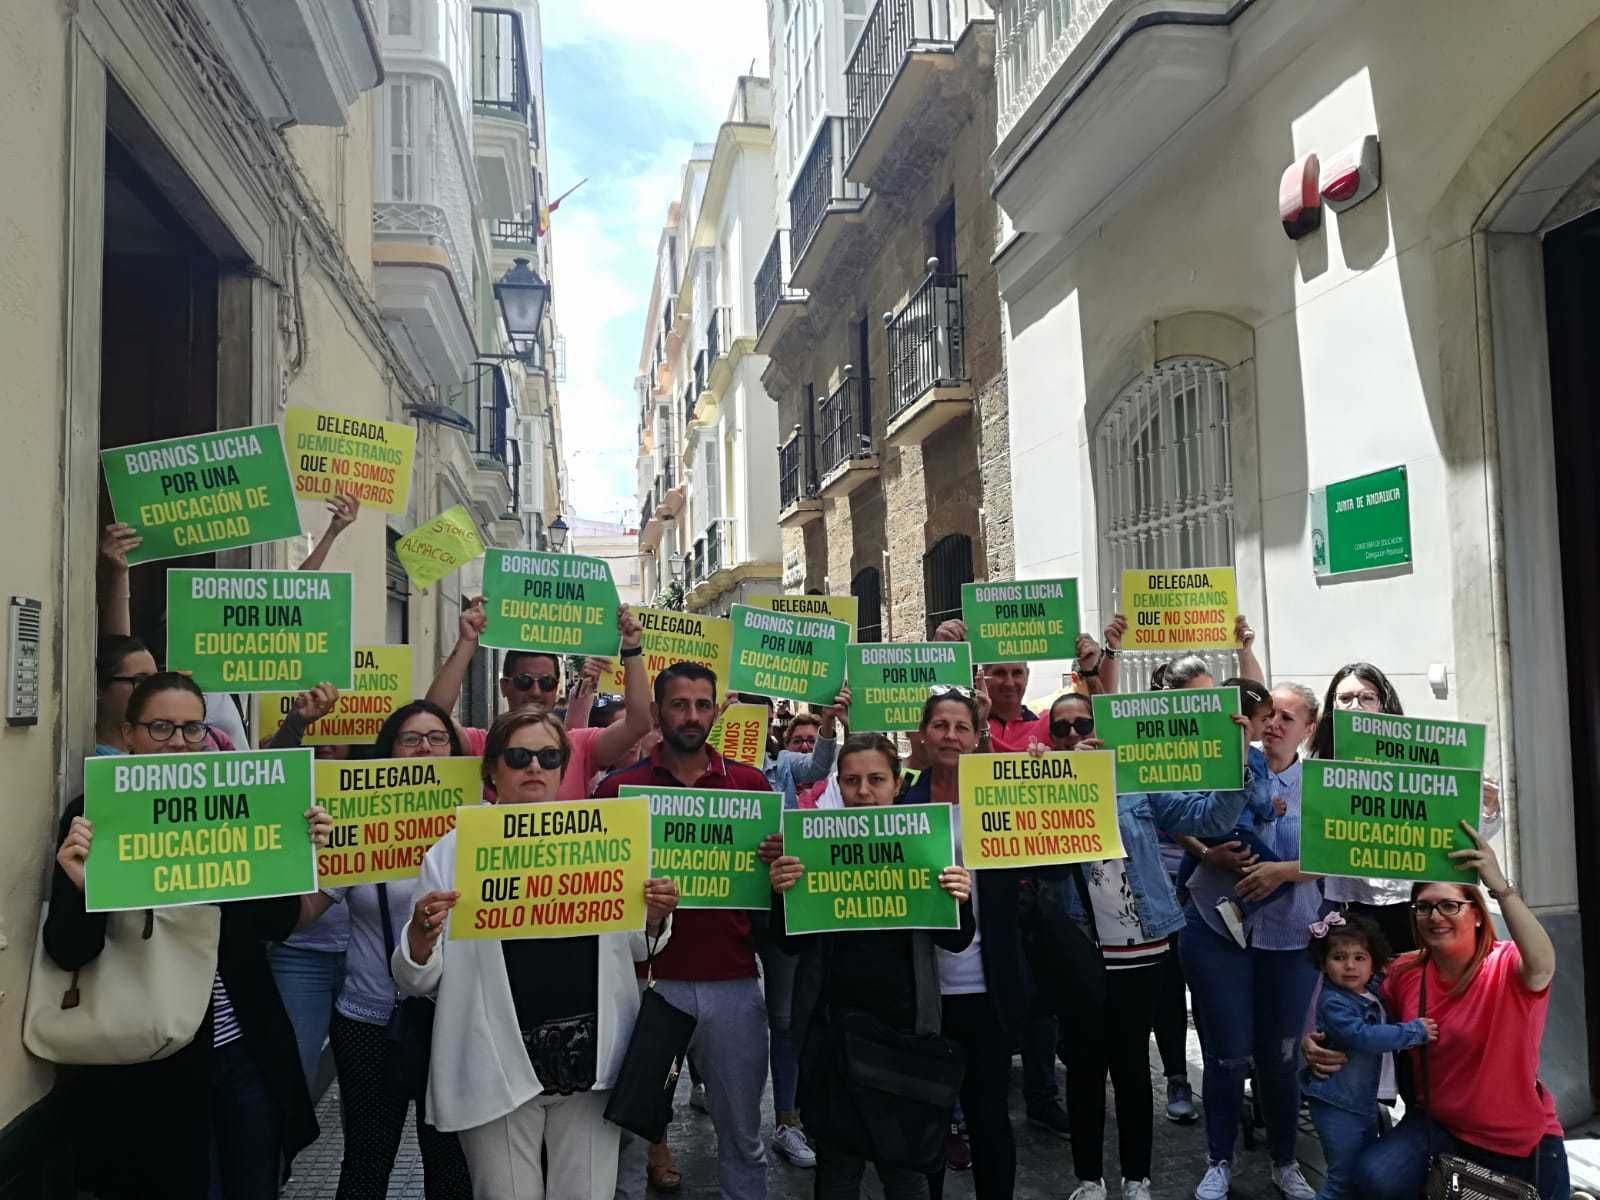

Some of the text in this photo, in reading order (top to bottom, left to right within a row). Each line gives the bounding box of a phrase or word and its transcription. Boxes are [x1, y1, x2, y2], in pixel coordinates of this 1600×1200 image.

[317, 415, 388, 444] DELEGADA,
[125, 435, 262, 475] BORNOS LUCHA
[297, 431, 402, 465] DEMUÉSTRANOS
[161, 465, 240, 495] POR UNA
[300, 454, 395, 484] QUE NO SOMOS
[296, 475, 394, 504] SOLO NÚM3ROS
[140, 486, 270, 526] EDUCACIÓN DE
[1336, 498, 1354, 512] JUNTA
[1356, 496, 1364, 508] DE
[174, 516, 250, 546] CALIDAD
[502, 555, 608, 582] BORNOS LUCHA
[192, 577, 331, 599] BORNOS LUCHA
[524, 579, 584, 600] POR UNA
[976, 584, 1063, 602] BORNOS LUCHA
[1149, 574, 1212, 590] DELEGADA,
[772, 599, 831, 615] DELEGADA,
[995, 603, 1045, 619] POR UNA
[1133, 590, 1228, 608] DEMUÉSTRANOS
[224, 606, 302, 626] POR UNA
[501, 599, 603, 625] EDUCACIÓN DE
[1138, 610, 1225, 625] QUE NO SOMOS
[521, 624, 582, 646] CALIDAD
[745, 611, 835, 640] BORNOS LUCHA
[980, 619, 1064, 638] EDUCACIÓN DE
[1136, 626, 1227, 643] SOLO NÚM3ROS
[195, 629, 328, 655] EDUCACIÓN DE
[761, 634, 813, 656] POR UNA
[998, 639, 1047, 656] CALIDAD
[648, 654, 665, 671] NO
[740, 649, 829, 678] EDUCACIÓN DE
[862, 648, 956, 664] BORNOS LUCHA
[223, 660, 302, 682] CALIDAD
[755, 672, 808, 694] CALIDAD
[883, 667, 936, 684] POR UNA
[340, 696, 392, 714] SOMOS
[866, 684, 928, 704] EDUCACIÓ
[1111, 694, 1222, 718] BORNOS LUCHA
[320, 716, 384, 736] NÚM3RO
[1136, 718, 1199, 739] POR UNA
[1352, 716, 1467, 746] BORNOS LUCHA
[723, 722, 740, 758] OMOS
[1117, 738, 1222, 762] EDUCACIÓN DE
[1376, 740, 1404, 759] POR
[1409, 745, 1440, 766] UNA
[115, 759, 285, 792] BORNOS LUCHA
[340, 764, 440, 791] DELEGADA,
[994, 759, 1077, 780] DELEGADA,
[1139, 764, 1202, 783] CALIDAD
[975, 782, 1099, 806] DEMUÉSTRANOS
[1323, 768, 1458, 796] BORNOS LUCHA
[154, 794, 249, 824] POR UNA
[649, 794, 762, 820] ORNOS LUCHA
[1351, 795, 1427, 821] POR UNA
[504, 809, 608, 838] DELEGADA,
[803, 813, 930, 839] BORNOS LUCHA
[982, 809, 1095, 832] QUE NO SOMOS
[119, 823, 282, 861] EDUCACIÓN DE
[364, 822, 389, 844] NO
[664, 822, 733, 844] POR UNA
[1325, 819, 1453, 849] EDUCACIÓN DE
[476, 838, 631, 872] DEMUÉSTRANOS
[831, 842, 904, 865] POR UNA
[981, 833, 1103, 858] SOLO NÚM3ROS
[318, 852, 365, 876] SOLO
[650, 847, 756, 872] DUCACIÓN DE
[1350, 848, 1425, 872] CALIDAD
[154, 860, 250, 893] CALIDAD
[481, 869, 624, 903] QUE NO SOMOS
[664, 876, 730, 898] ALIDAD
[808, 866, 931, 893] EDUCACIÓN DE
[475, 899, 624, 930] SOLO NÚM3ROS
[834, 896, 907, 919] CALIDAD
